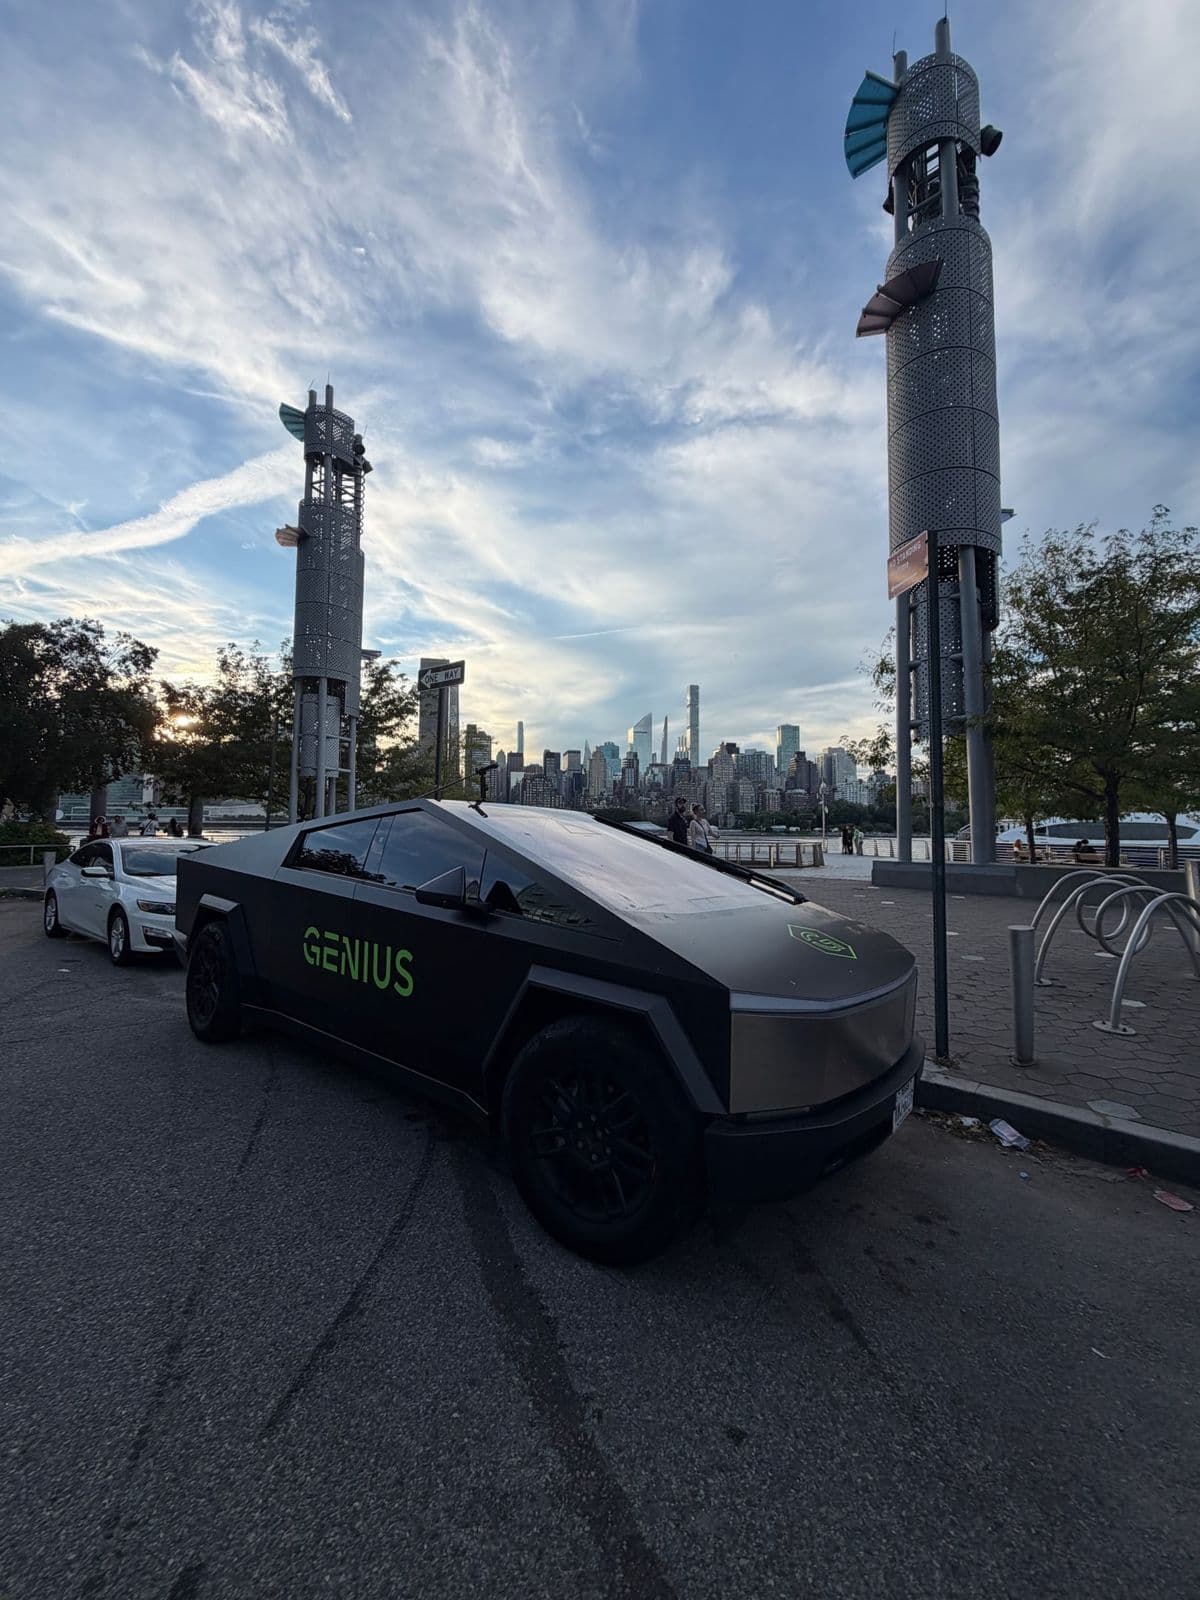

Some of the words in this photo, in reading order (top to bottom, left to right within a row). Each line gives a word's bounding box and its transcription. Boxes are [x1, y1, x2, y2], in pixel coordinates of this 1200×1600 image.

[424, 672, 438, 684] ONE
[444, 668, 460, 681] WAY
[303, 926, 414, 997] GENIUS
